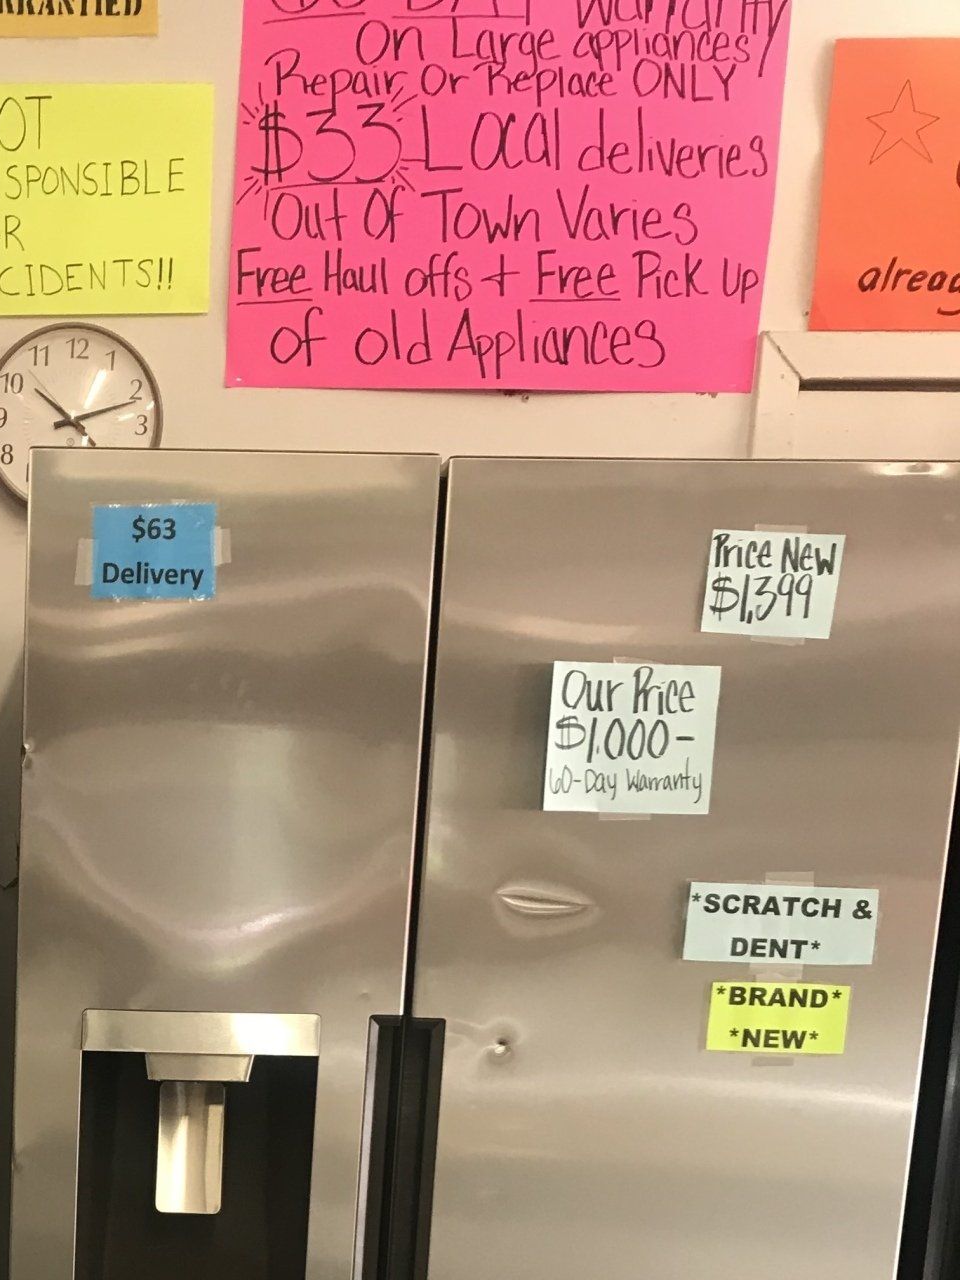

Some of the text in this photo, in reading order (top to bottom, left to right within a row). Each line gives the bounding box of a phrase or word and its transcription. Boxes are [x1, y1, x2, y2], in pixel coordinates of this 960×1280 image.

[356, 17, 750, 78] On Large appliances
[264, 48, 736, 116] Repair Or Replace ONLY
[251, 100, 402, 184] $33
[578, 106, 768, 179] deliveries
[272, 188, 347, 241] Out
[421, 187, 540, 243] Town
[556, 184, 698, 245] Varies
[237, 247, 313, 297] Free
[324, 248, 388, 295] Haul
[405, 251, 472, 301] offs
[537, 249, 620, 298] Free
[632, 250, 709, 299] Pick
[722, 257, 759, 304] Up
[28, 345, 49, 366] 11
[66, 337, 89, 359] 12
[355, 308, 432, 365] old
[447, 308, 666, 380] Appliances
[105, 350, 116, 371] 1
[0, 372, 24, 394] 10
[129, 379, 143, 401] 2
[134, 414, 148, 435] 3
[0, 443, 13, 465] 8
[132, 515, 176, 543] $63
[713, 533, 773, 569] Price
[102, 561, 204, 590] Delivery
[709, 571, 813, 624] $1,399
[561, 666, 696, 715] Our Price
[626, 757, 702, 804] Warranty
[852, 899, 873, 920] &
